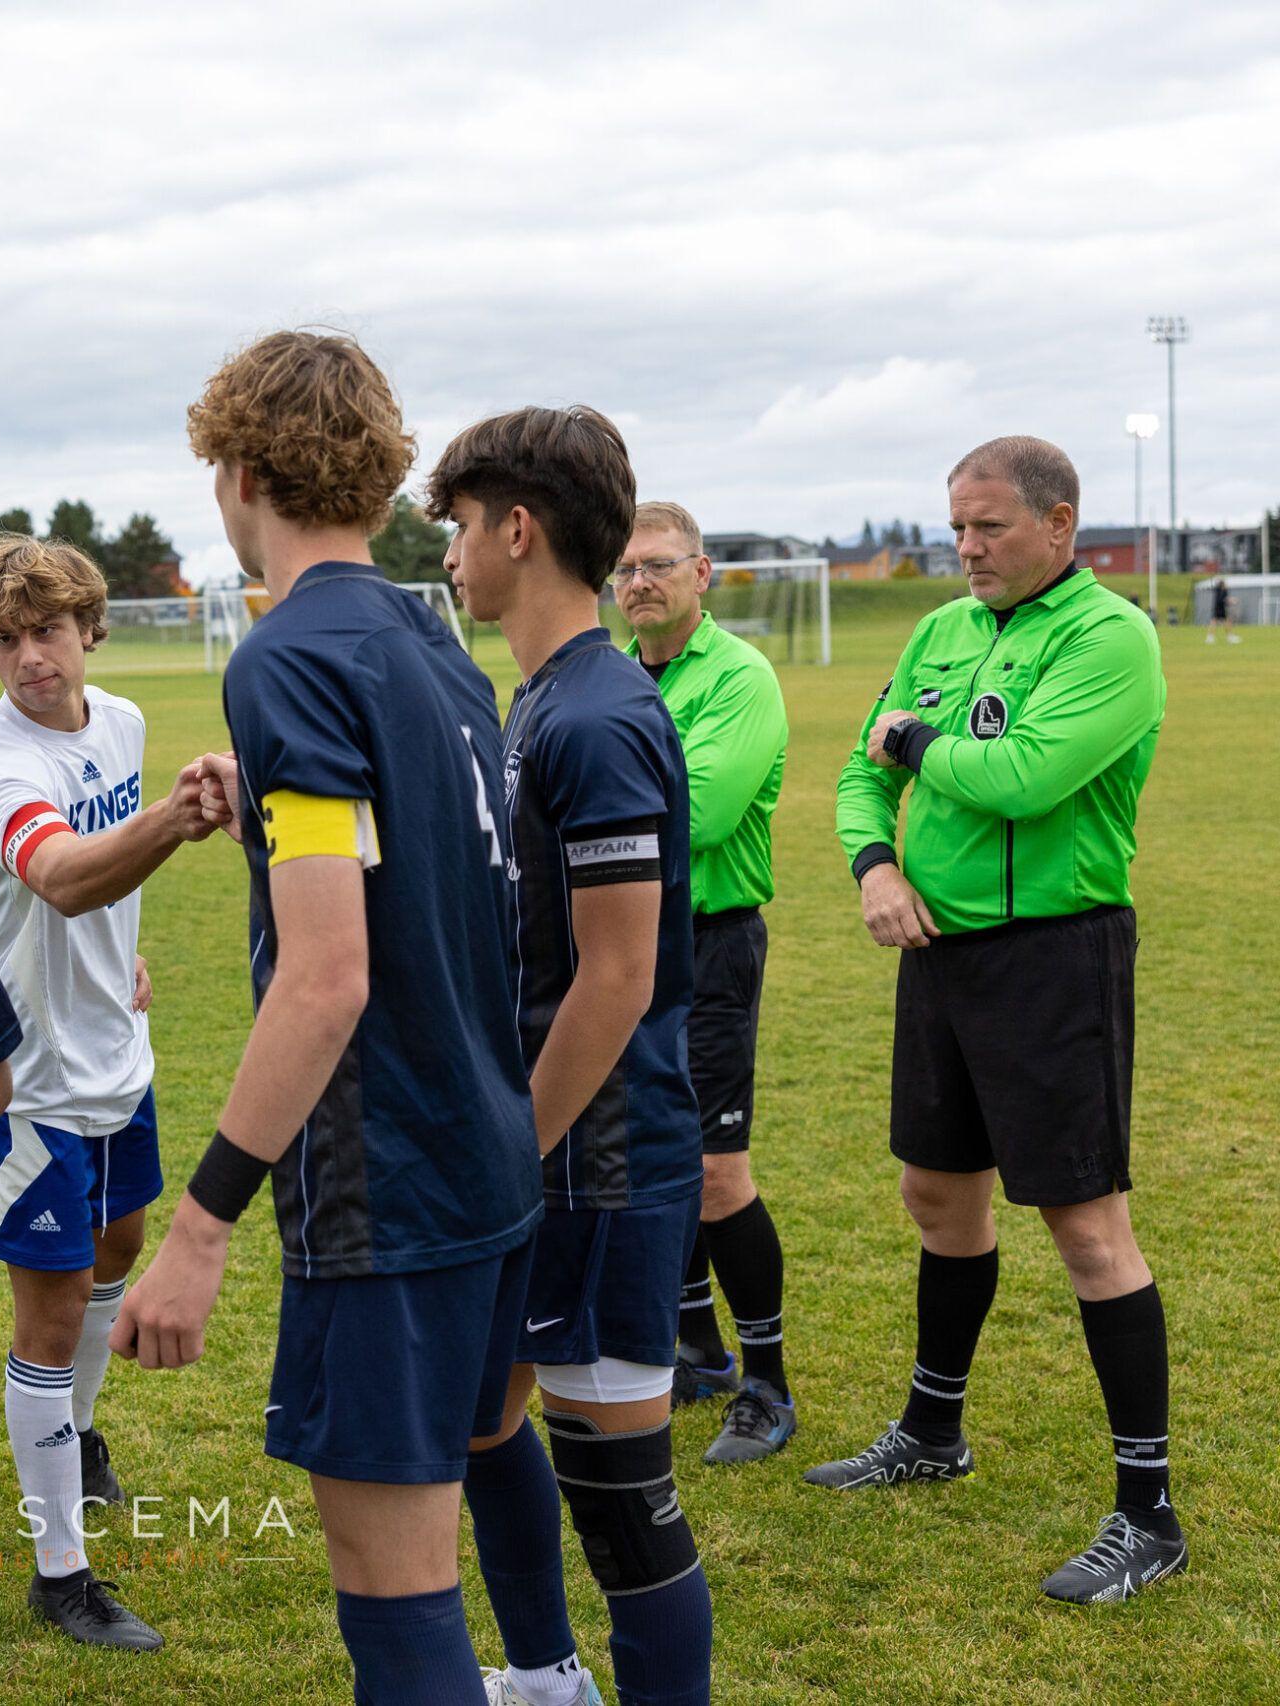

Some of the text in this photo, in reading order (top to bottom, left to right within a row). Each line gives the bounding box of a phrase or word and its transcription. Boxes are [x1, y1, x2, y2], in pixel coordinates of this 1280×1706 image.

[69, 771, 140, 836] KINGS
[6, 819, 39, 865] CAPTAIN
[569, 841, 637, 858] APTAIN
[30, 1222, 61, 1232] adidas
[1141, 1560, 1163, 1582] EFFORT
